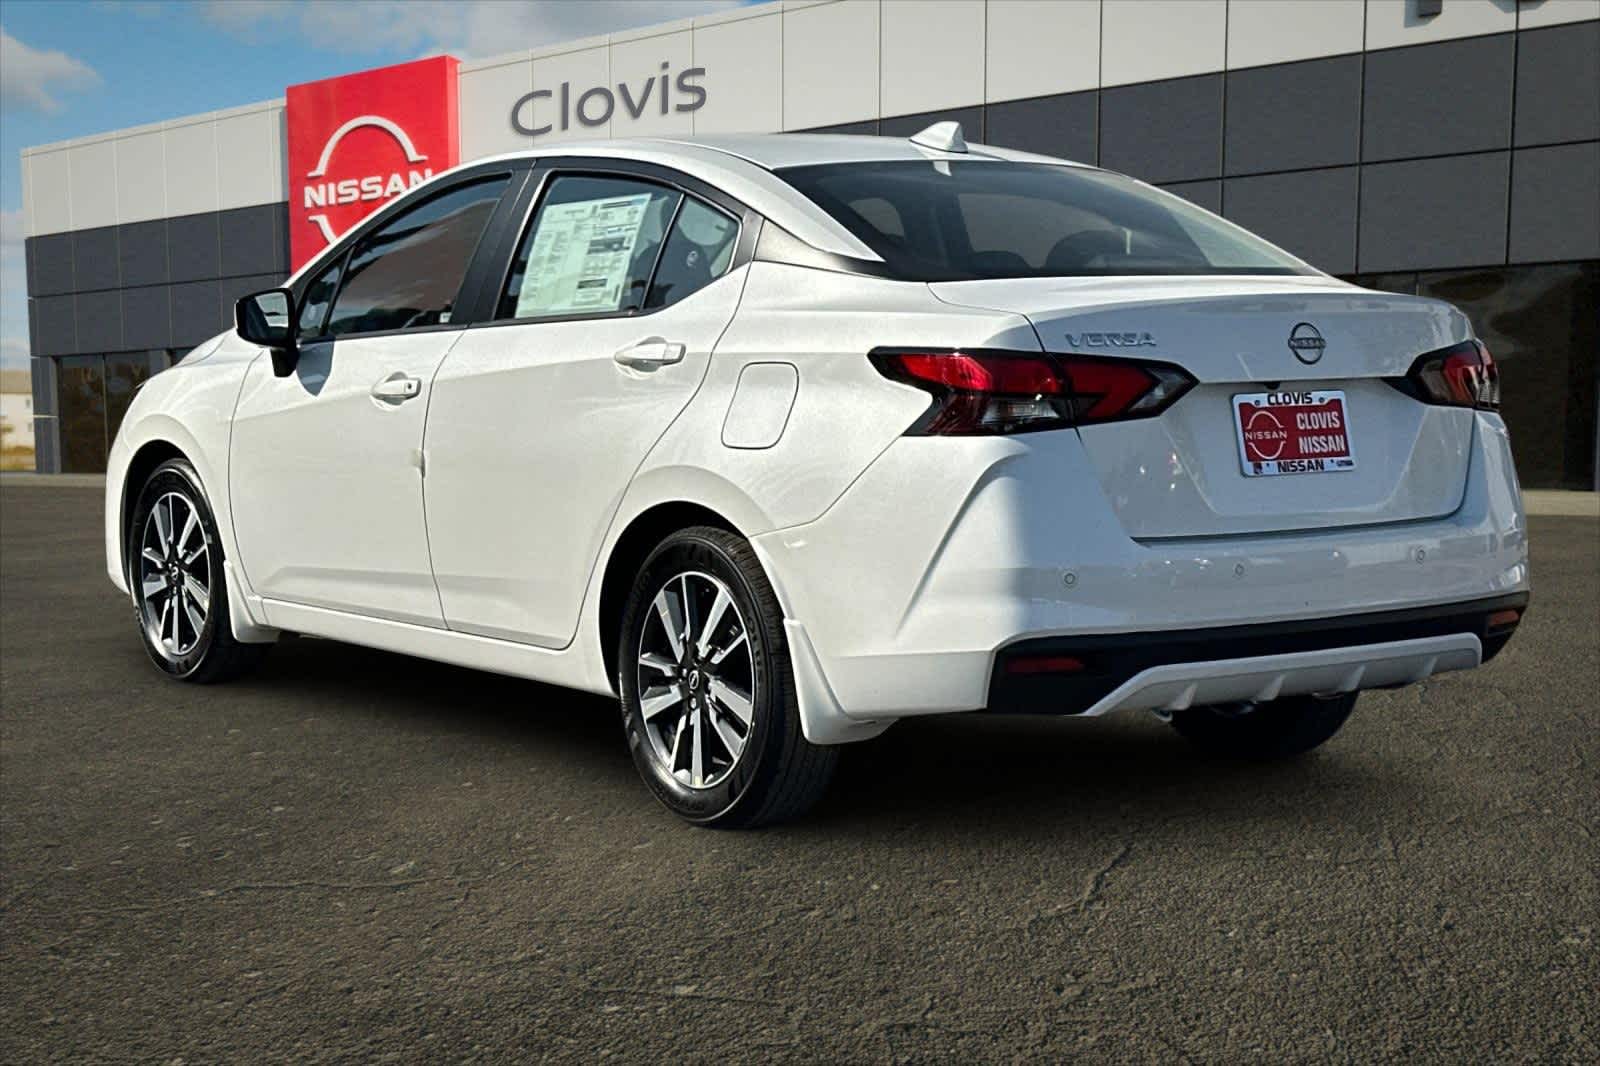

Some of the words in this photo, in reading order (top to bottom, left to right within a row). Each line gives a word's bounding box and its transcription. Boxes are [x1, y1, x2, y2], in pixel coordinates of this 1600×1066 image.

[511, 62, 706, 136] Clovis
[1064, 332, 1157, 348] VERSA
[1267, 392, 1313, 406] CLOVIS
[1296, 411, 1340, 430] CLOVIS
[1245, 431, 1288, 440] NISSAN
[1299, 434, 1346, 454] NISSAN
[1277, 460, 1325, 473] NISSAN
